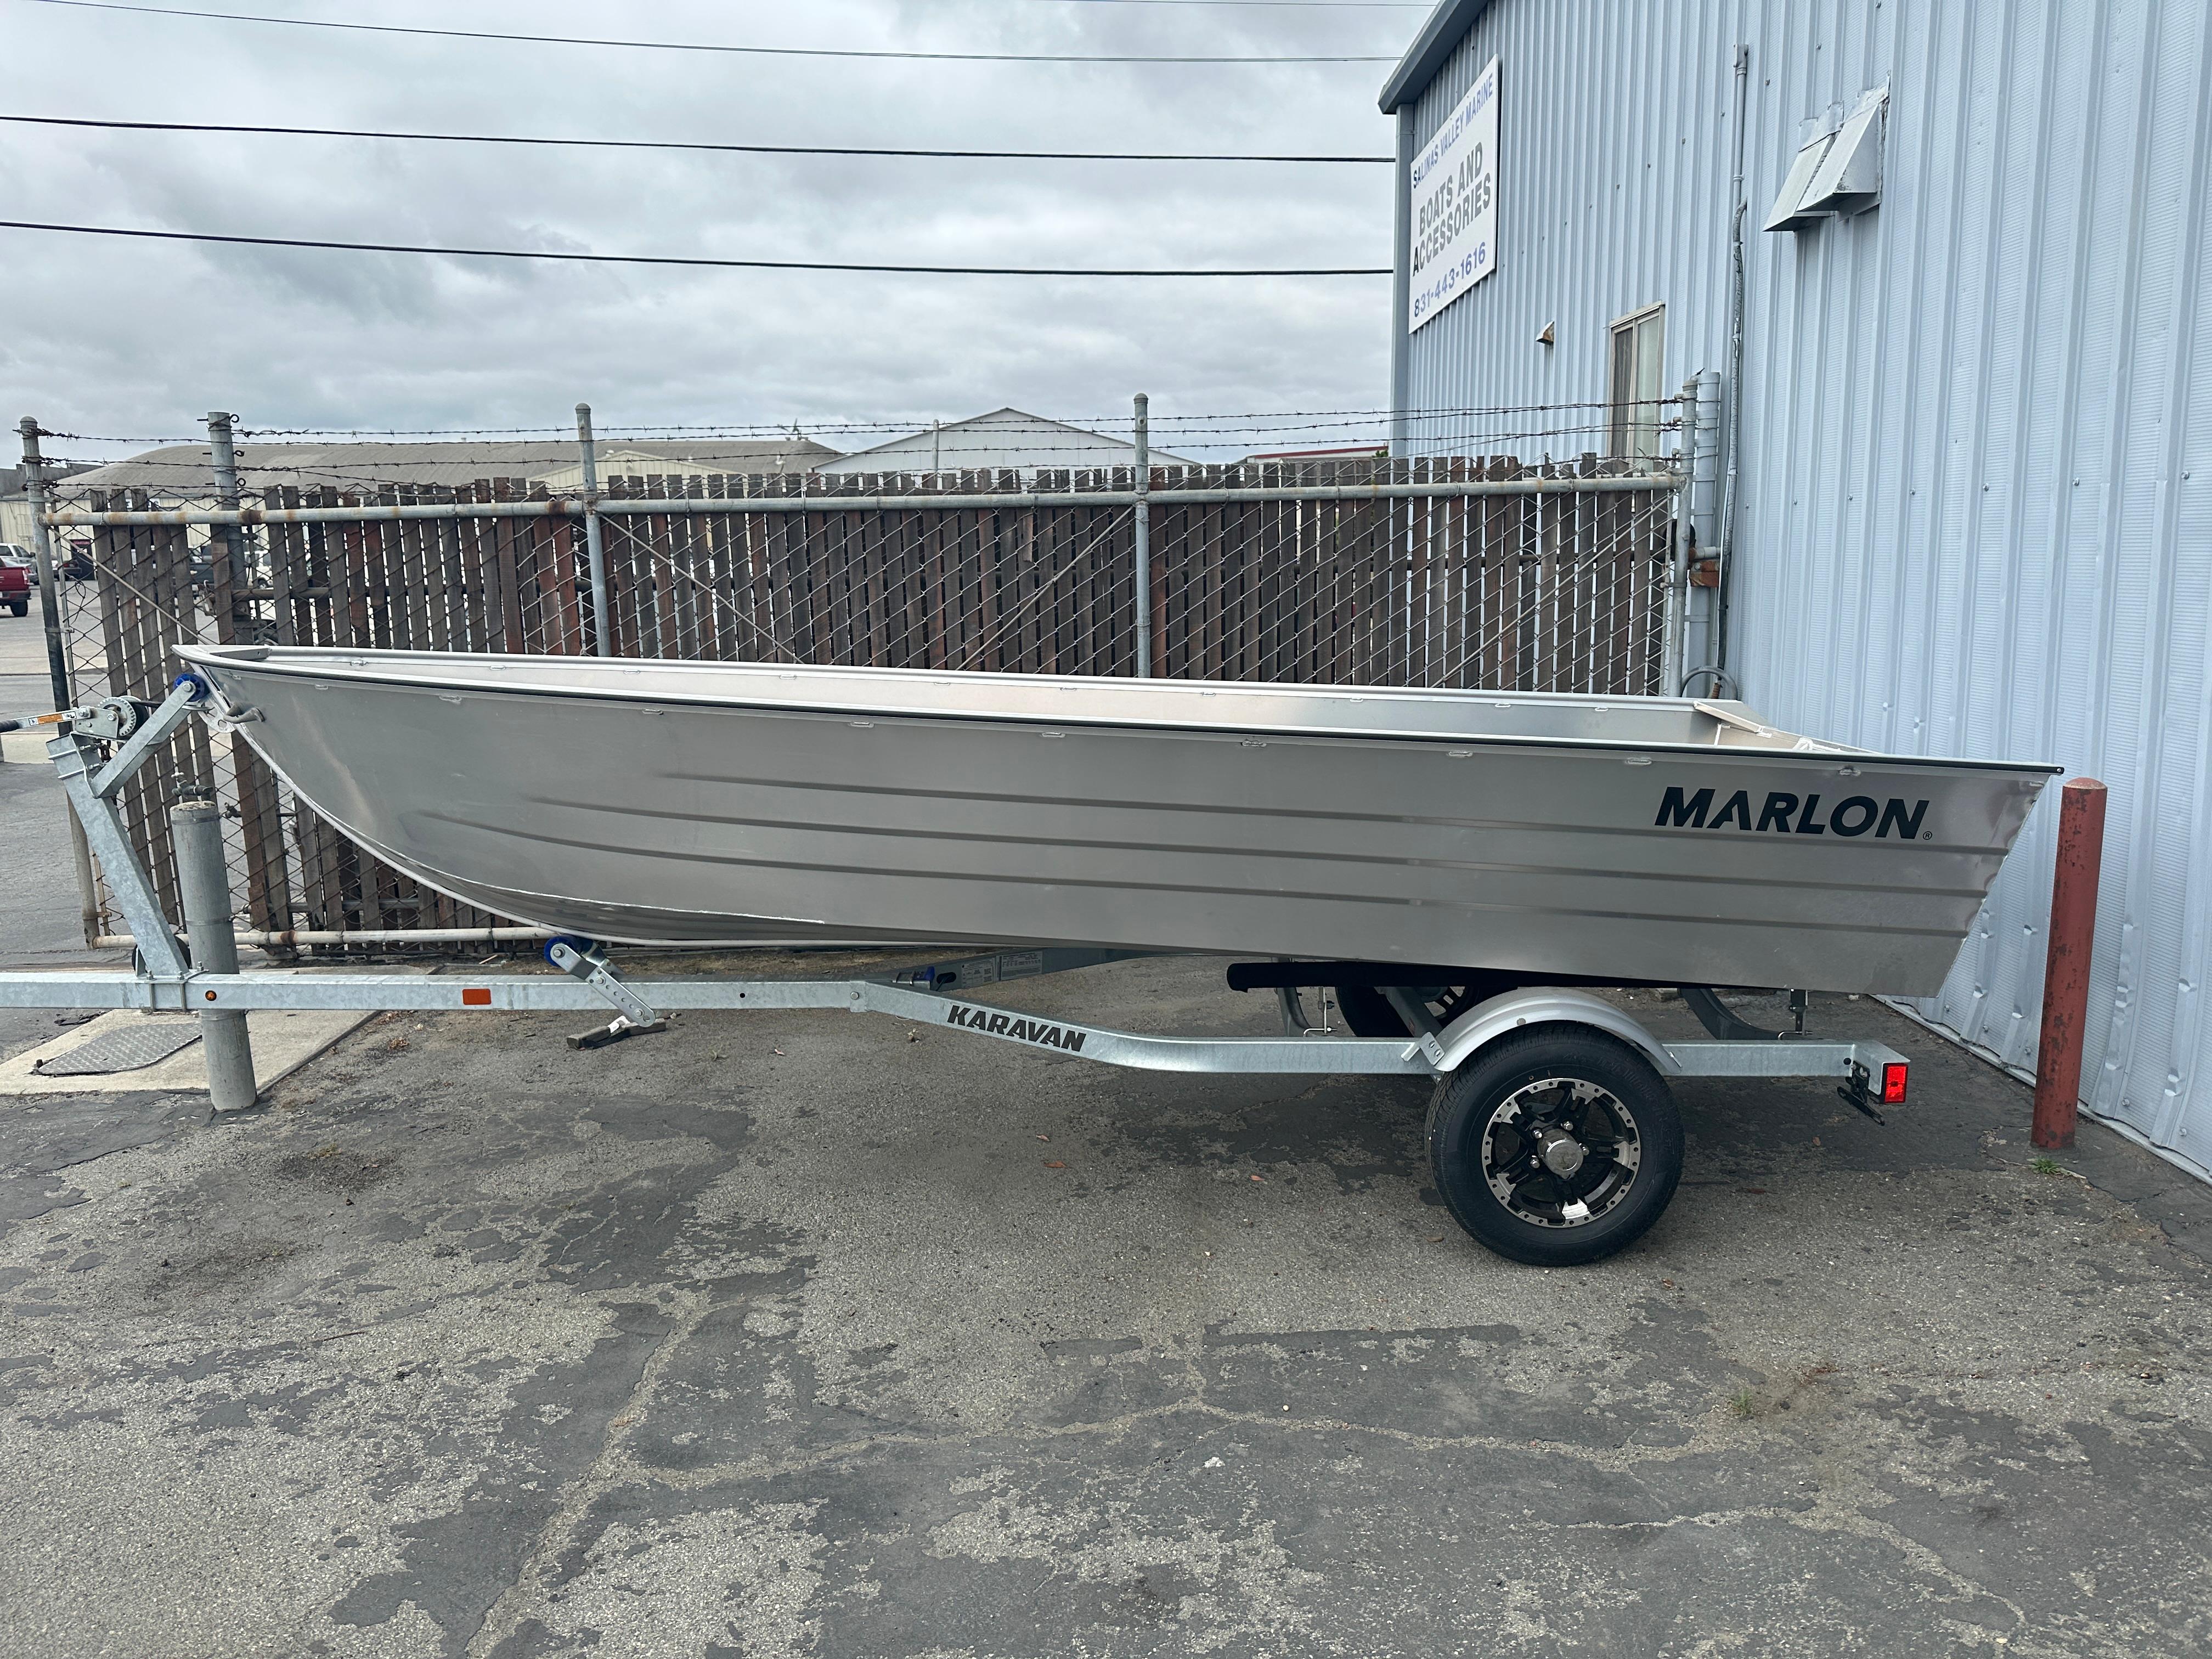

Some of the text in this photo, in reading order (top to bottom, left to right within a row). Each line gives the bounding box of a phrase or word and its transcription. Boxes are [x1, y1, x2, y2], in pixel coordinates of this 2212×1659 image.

[1413, 72, 1493, 189] SALINAS VALLEY MARINE
[1413, 172, 1491, 277] ACCESSORIES
[1419, 142, 1482, 237] BOATS AND
[1414, 242, 1486, 317] 831-443-1616
[1654, 786, 1930, 840] MARLON
[947, 1005, 1087, 1052] KARAVAN
